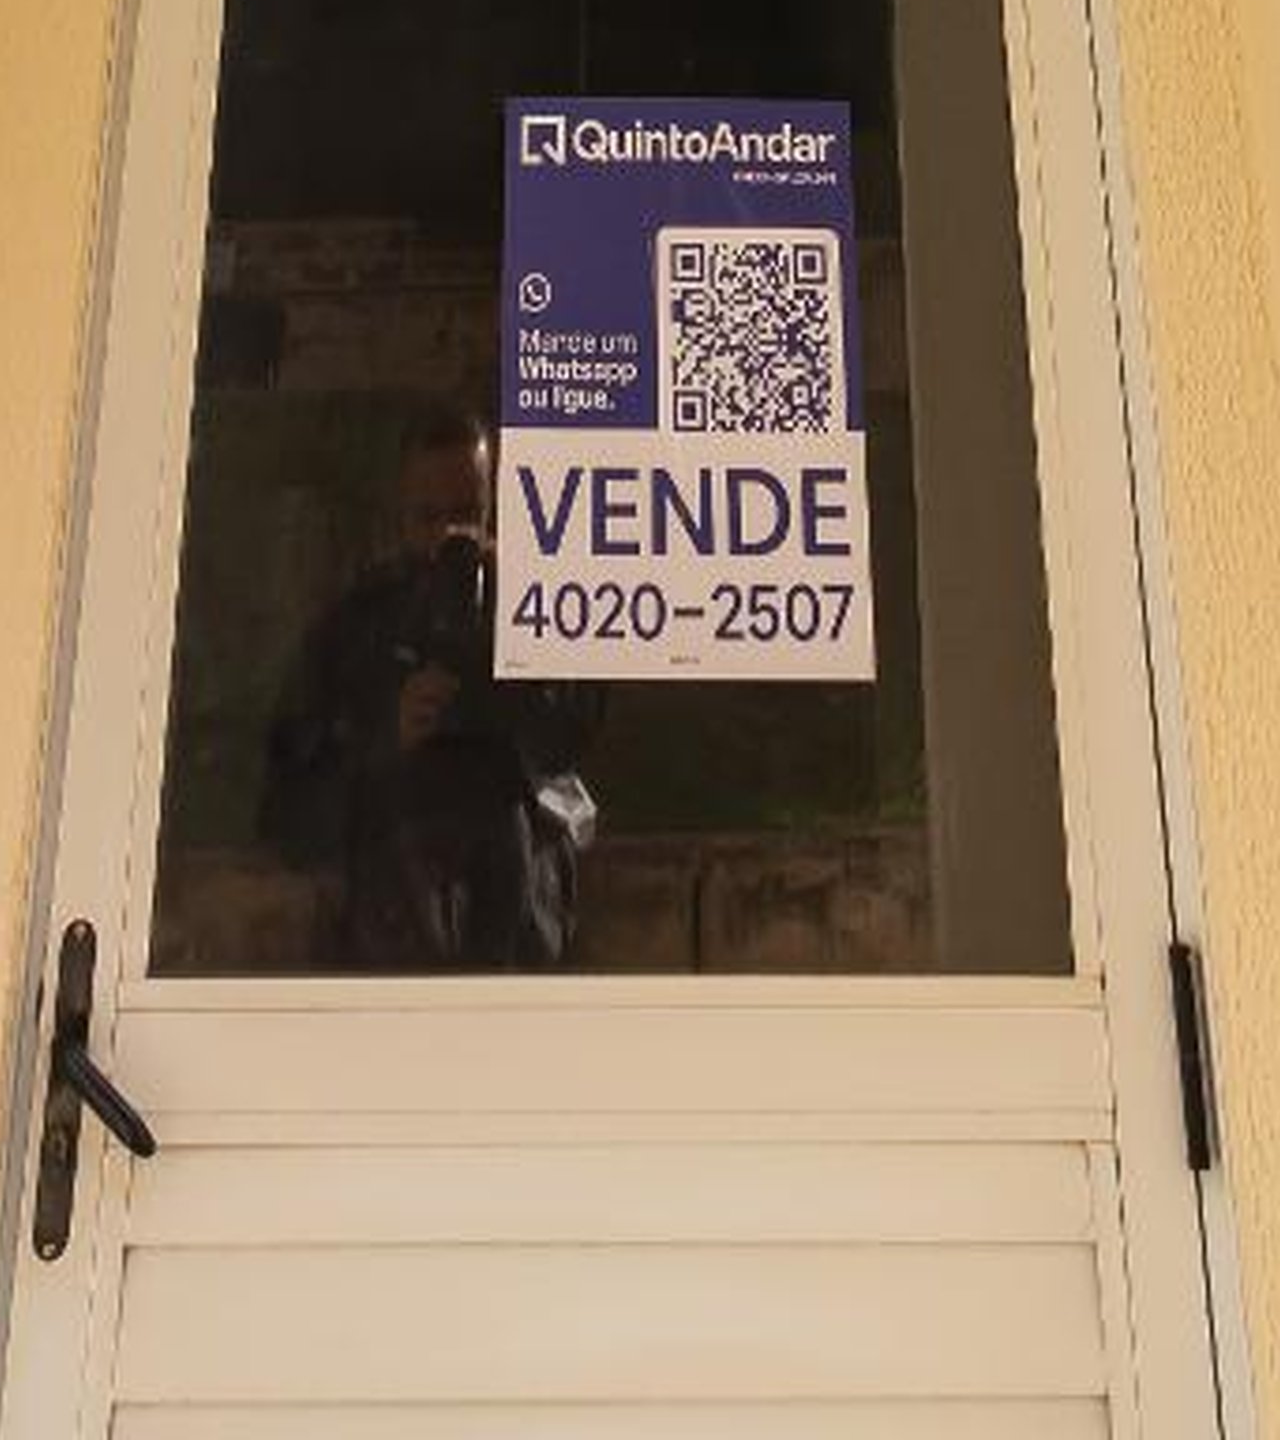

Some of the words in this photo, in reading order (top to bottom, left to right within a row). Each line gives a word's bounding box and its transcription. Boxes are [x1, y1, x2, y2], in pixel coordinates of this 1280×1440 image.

[572, 120, 836, 164] QuintoAndar
[518, 356, 639, 386] Whatsapp
[518, 389, 549, 409] ou
[552, 384, 617, 414] ligue.
[517, 467, 852, 558] VENDE
[512, 582, 855, 641] 4020-2507
